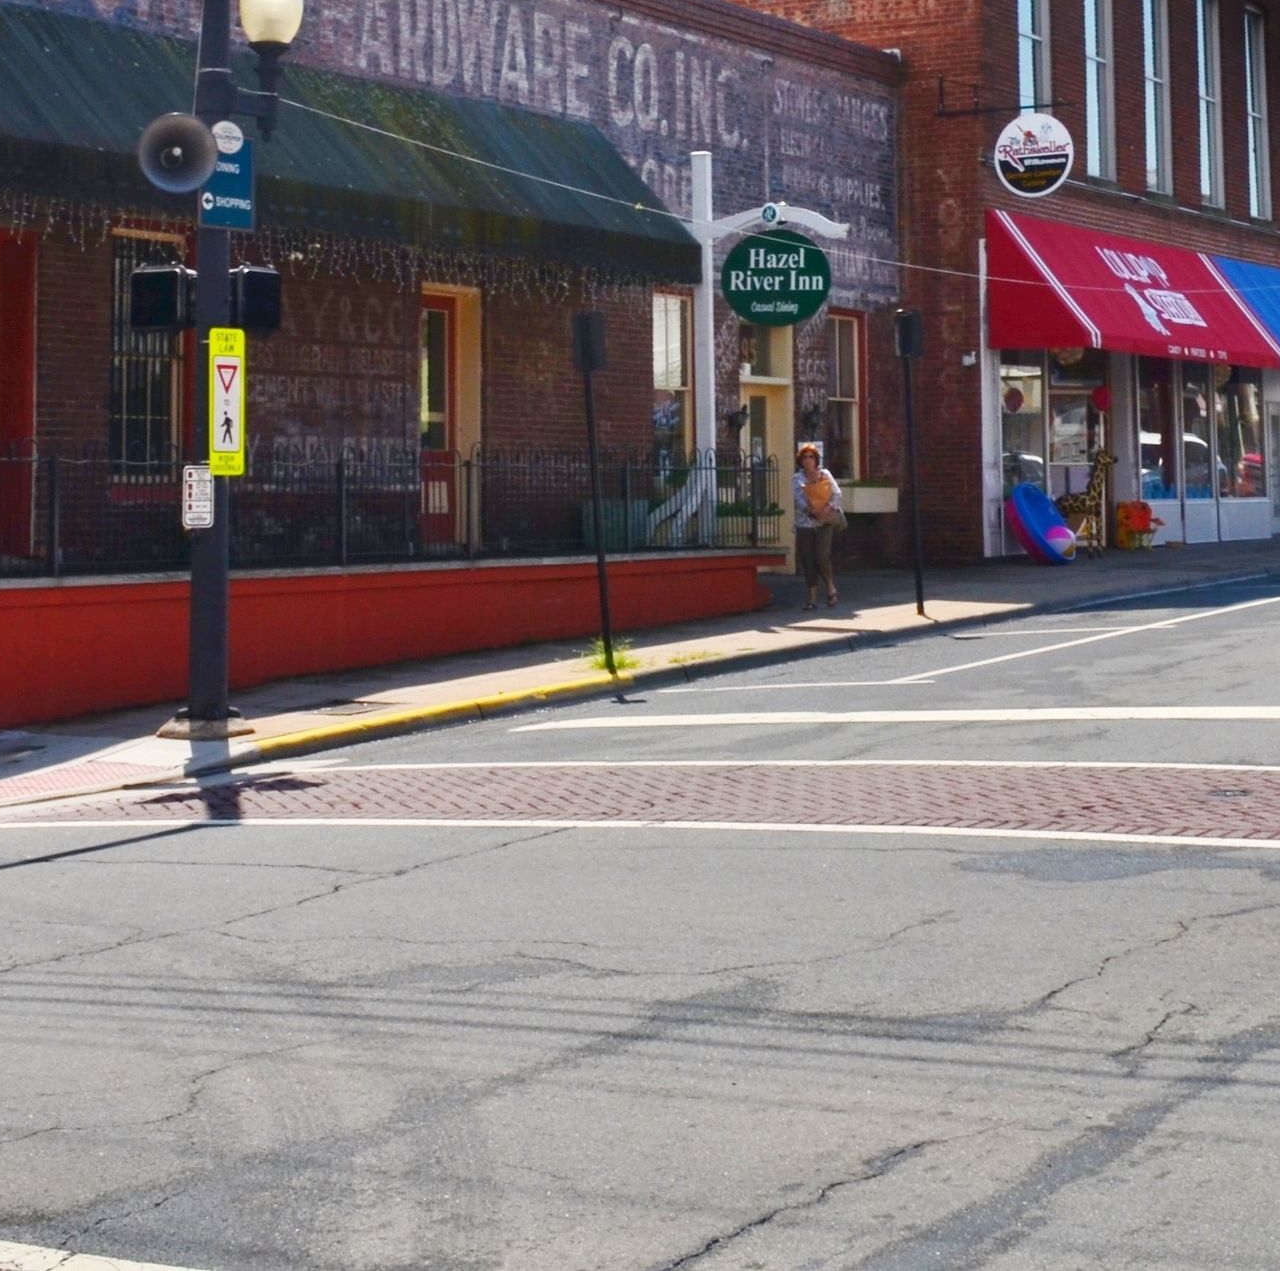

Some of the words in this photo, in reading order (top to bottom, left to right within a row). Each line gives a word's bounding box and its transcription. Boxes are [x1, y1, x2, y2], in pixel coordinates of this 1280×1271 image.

[216, 196, 251, 210] SHOPPING
[749, 247, 805, 269] Hazel
[730, 270, 784, 292] River
[790, 270, 825, 291] Inn
